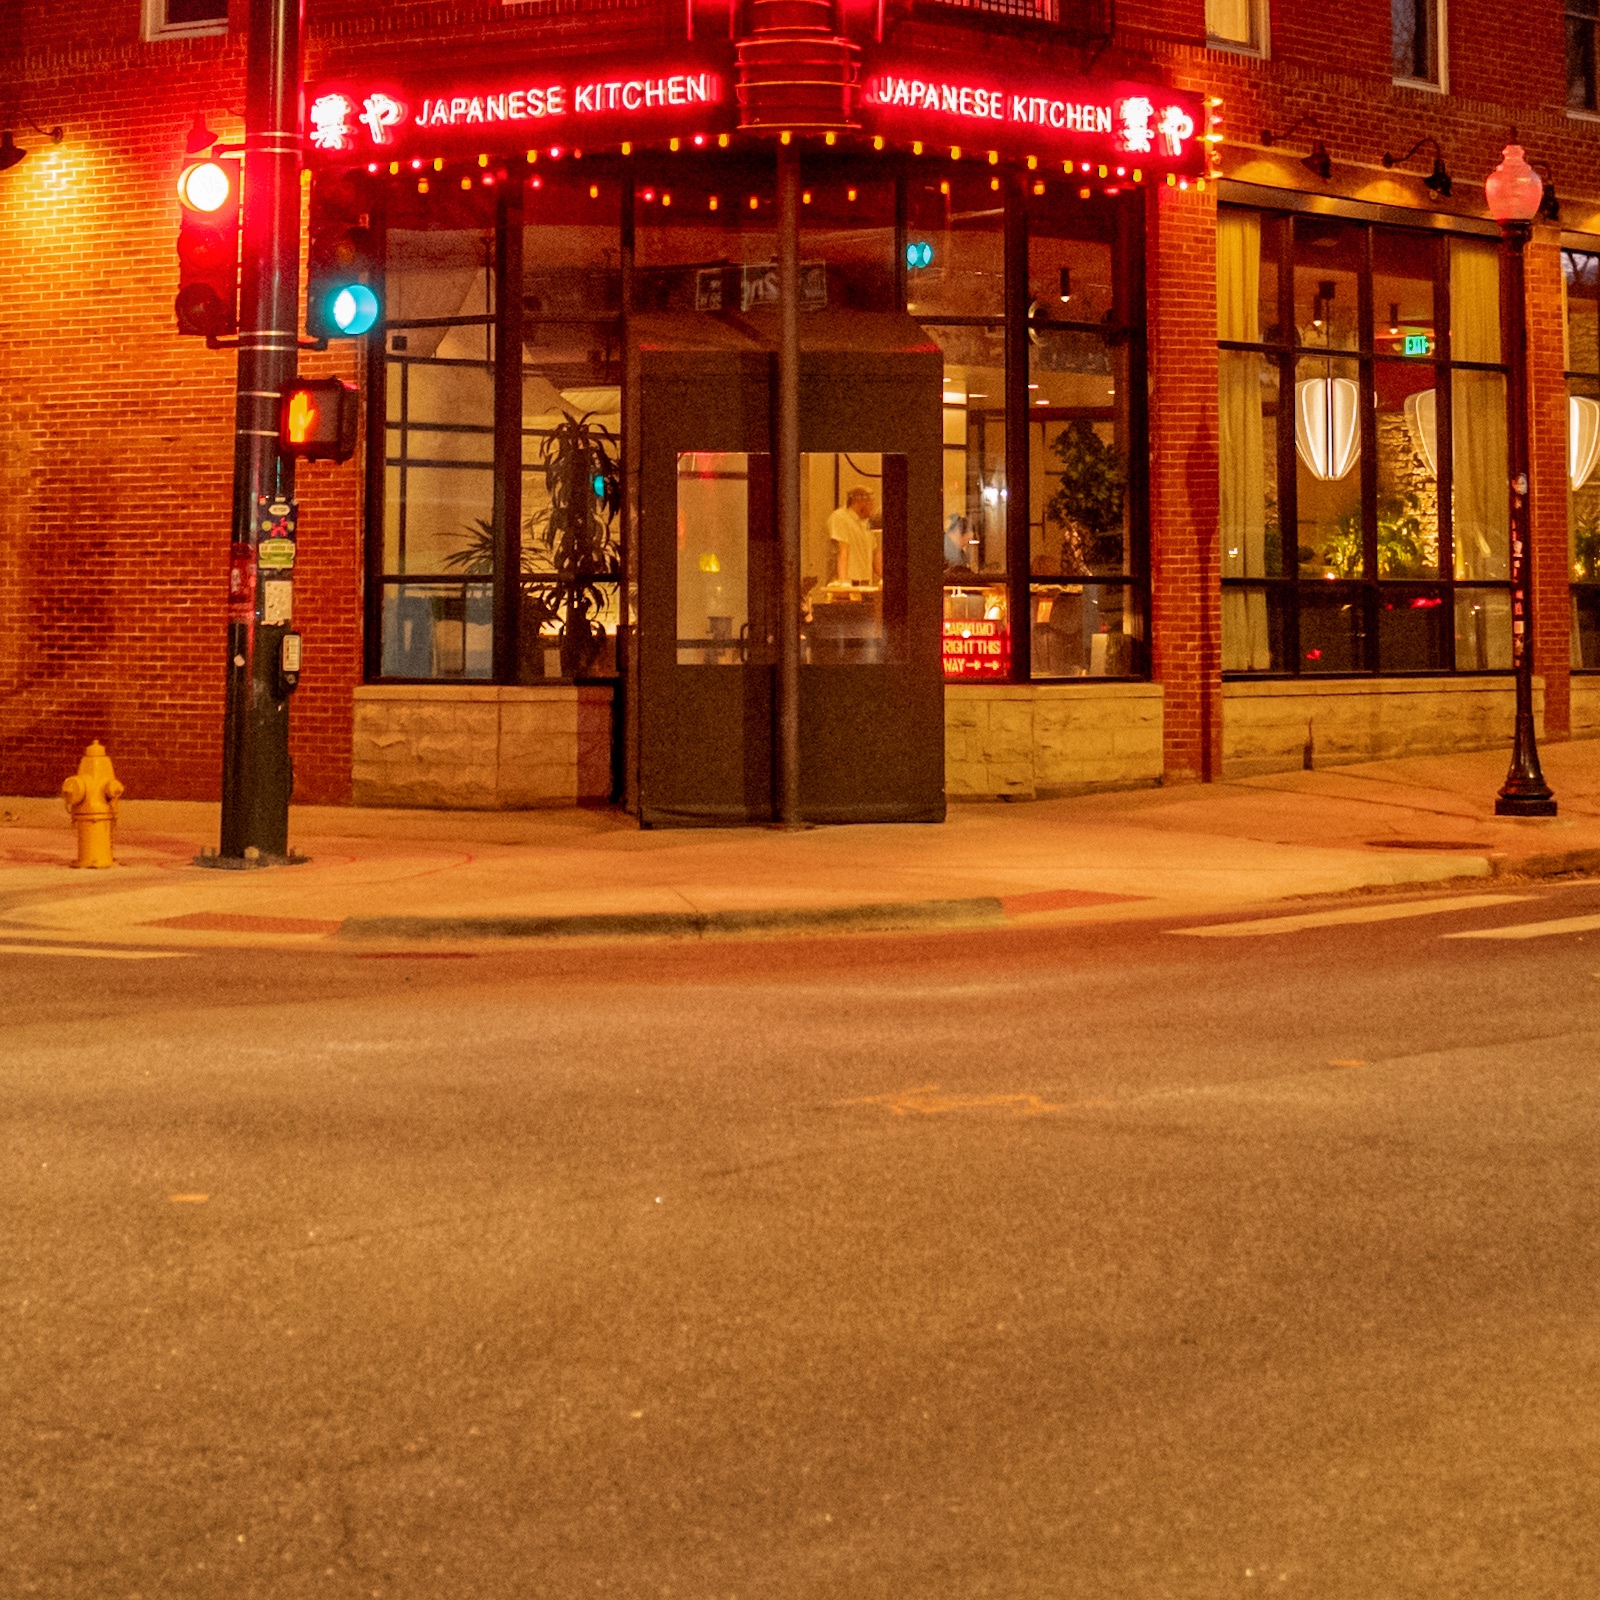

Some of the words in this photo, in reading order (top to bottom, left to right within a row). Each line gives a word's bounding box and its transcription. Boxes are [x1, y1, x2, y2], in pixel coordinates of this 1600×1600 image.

[415, 86, 563, 126] JAPANESE
[574, 72, 708, 112] KITCHEN
[878, 75, 1004, 120] JAPANESE
[1012, 94, 1113, 134] KITCHEN
[1405, 335, 1427, 355] EXIT
[943, 640, 975, 654] RIGHT
[975, 640, 1002, 654] THIS
[943, 658, 966, 673] WAY
